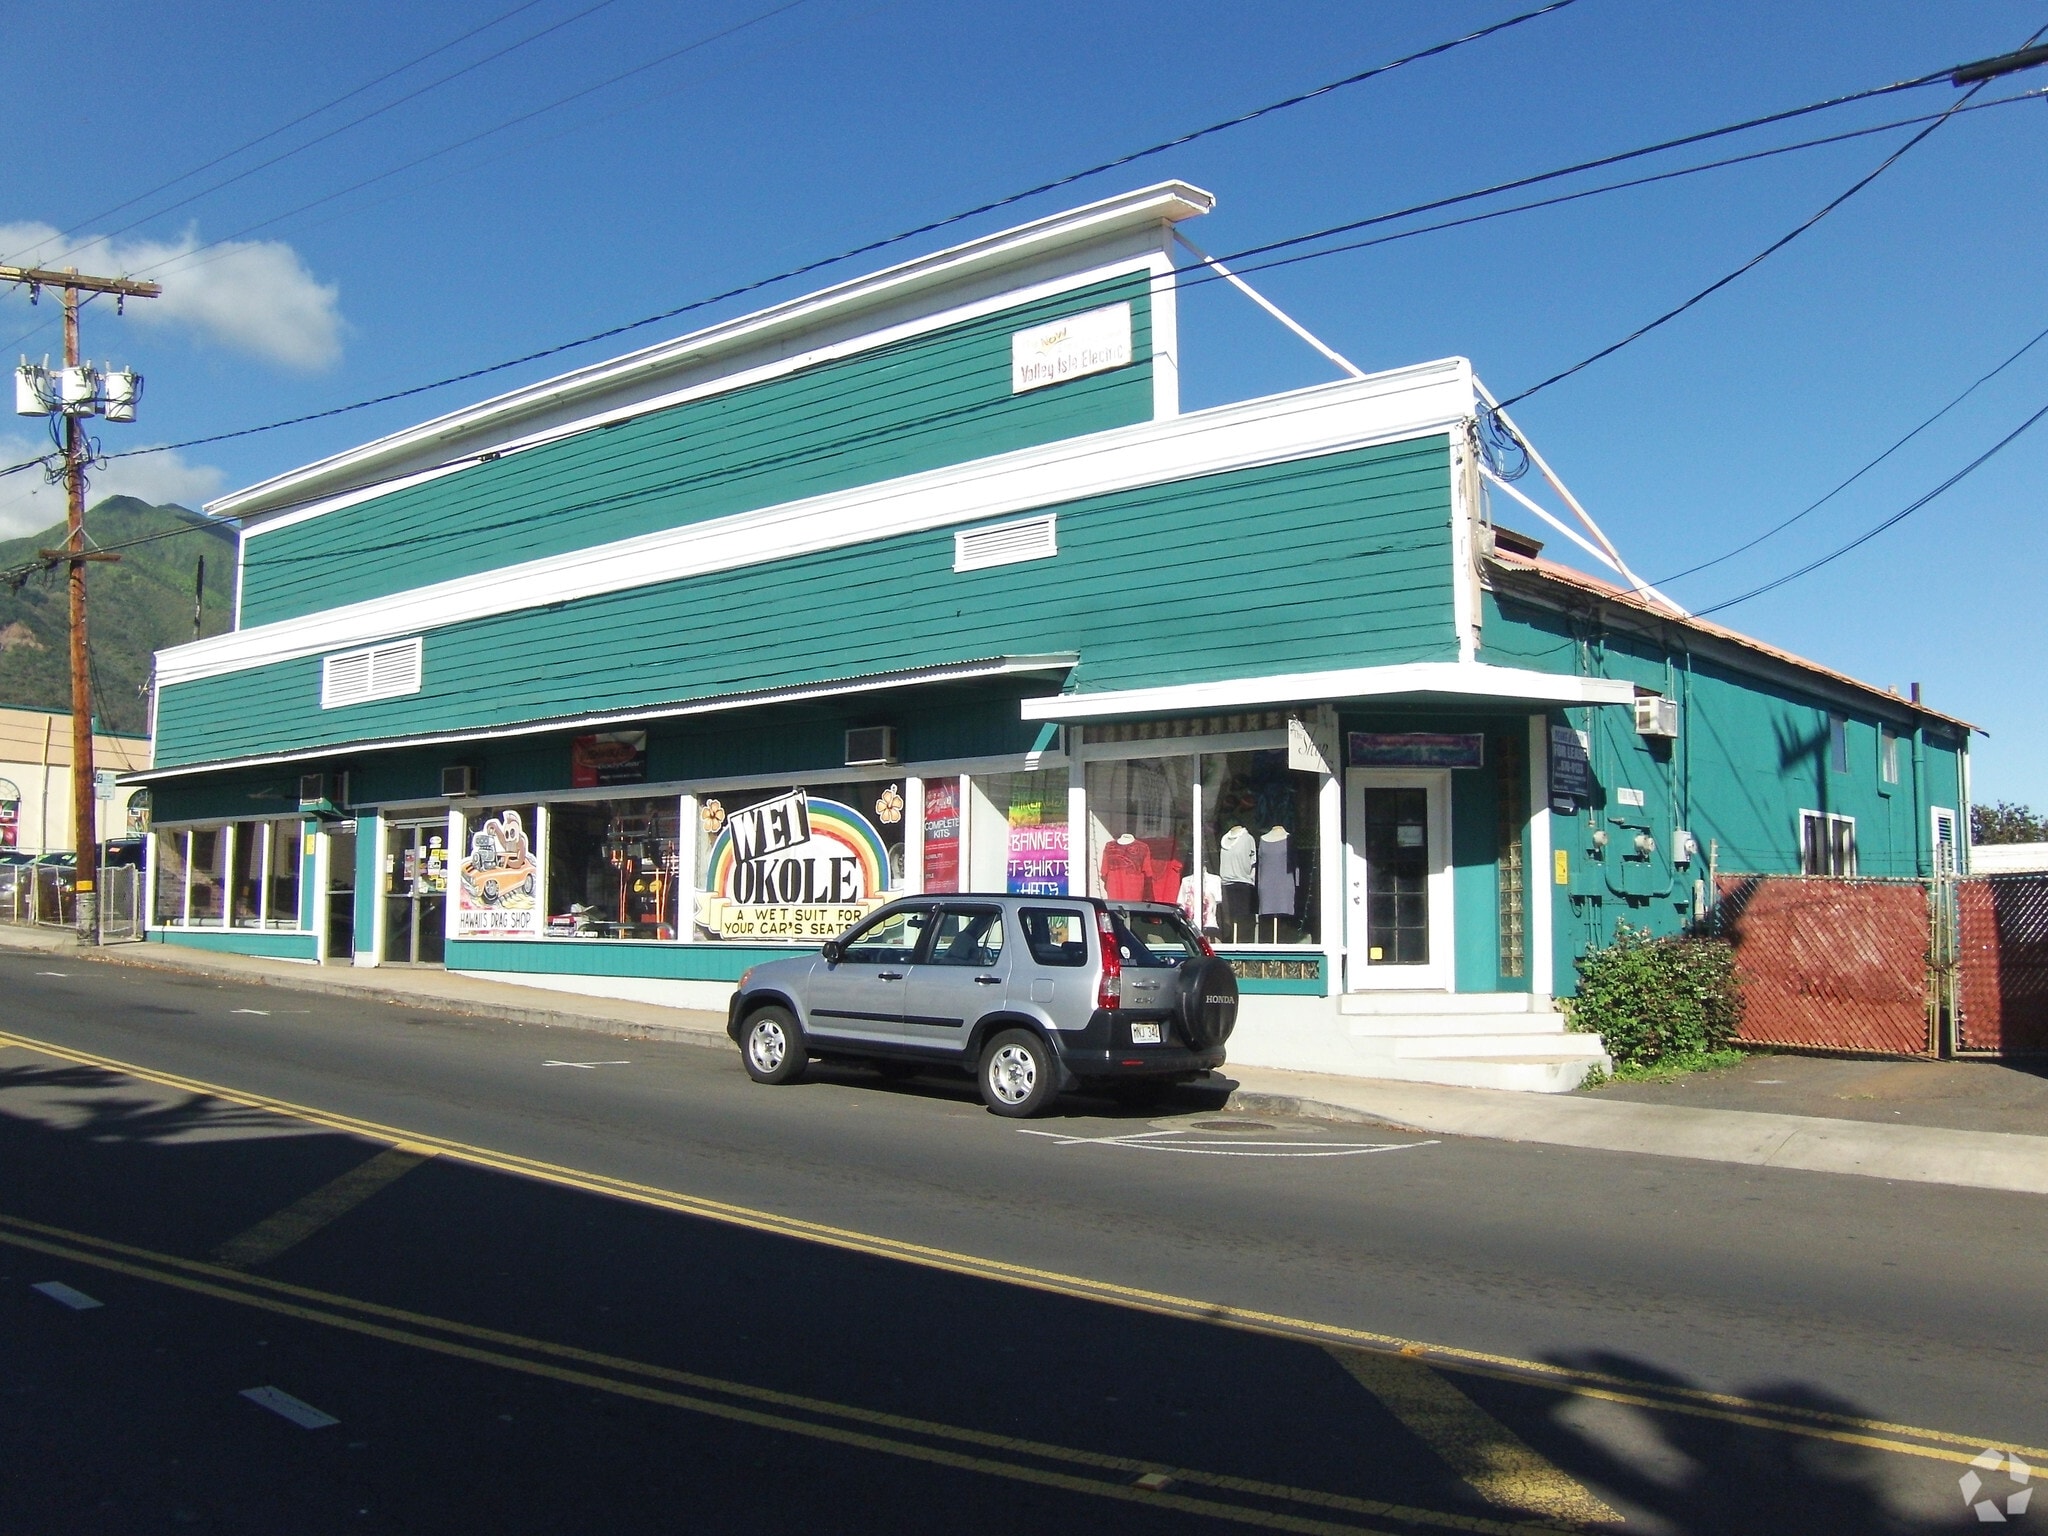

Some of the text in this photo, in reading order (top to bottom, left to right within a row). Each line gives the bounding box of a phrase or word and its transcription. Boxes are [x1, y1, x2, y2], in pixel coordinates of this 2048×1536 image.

[1020, 362, 1054, 383] Valley
[1057, 354, 1078, 374] Isle
[731, 792, 806, 861] WET
[924, 815, 960, 831] COMPLETE
[933, 828, 951, 839] KITS
[1011, 831, 1070, 852] BANNERS
[1009, 856, 1070, 878] T-SHIRTS
[733, 856, 858, 905] OKOLE
[490, 912, 508, 928] DRAG
[511, 912, 531, 928] SHOP
[737, 908, 862, 921] A WET SUIT FOR
[724, 922, 755, 934] YOUR
[760, 922, 803, 935] CAR'S
[1206, 995, 1235, 1004] HONDA
